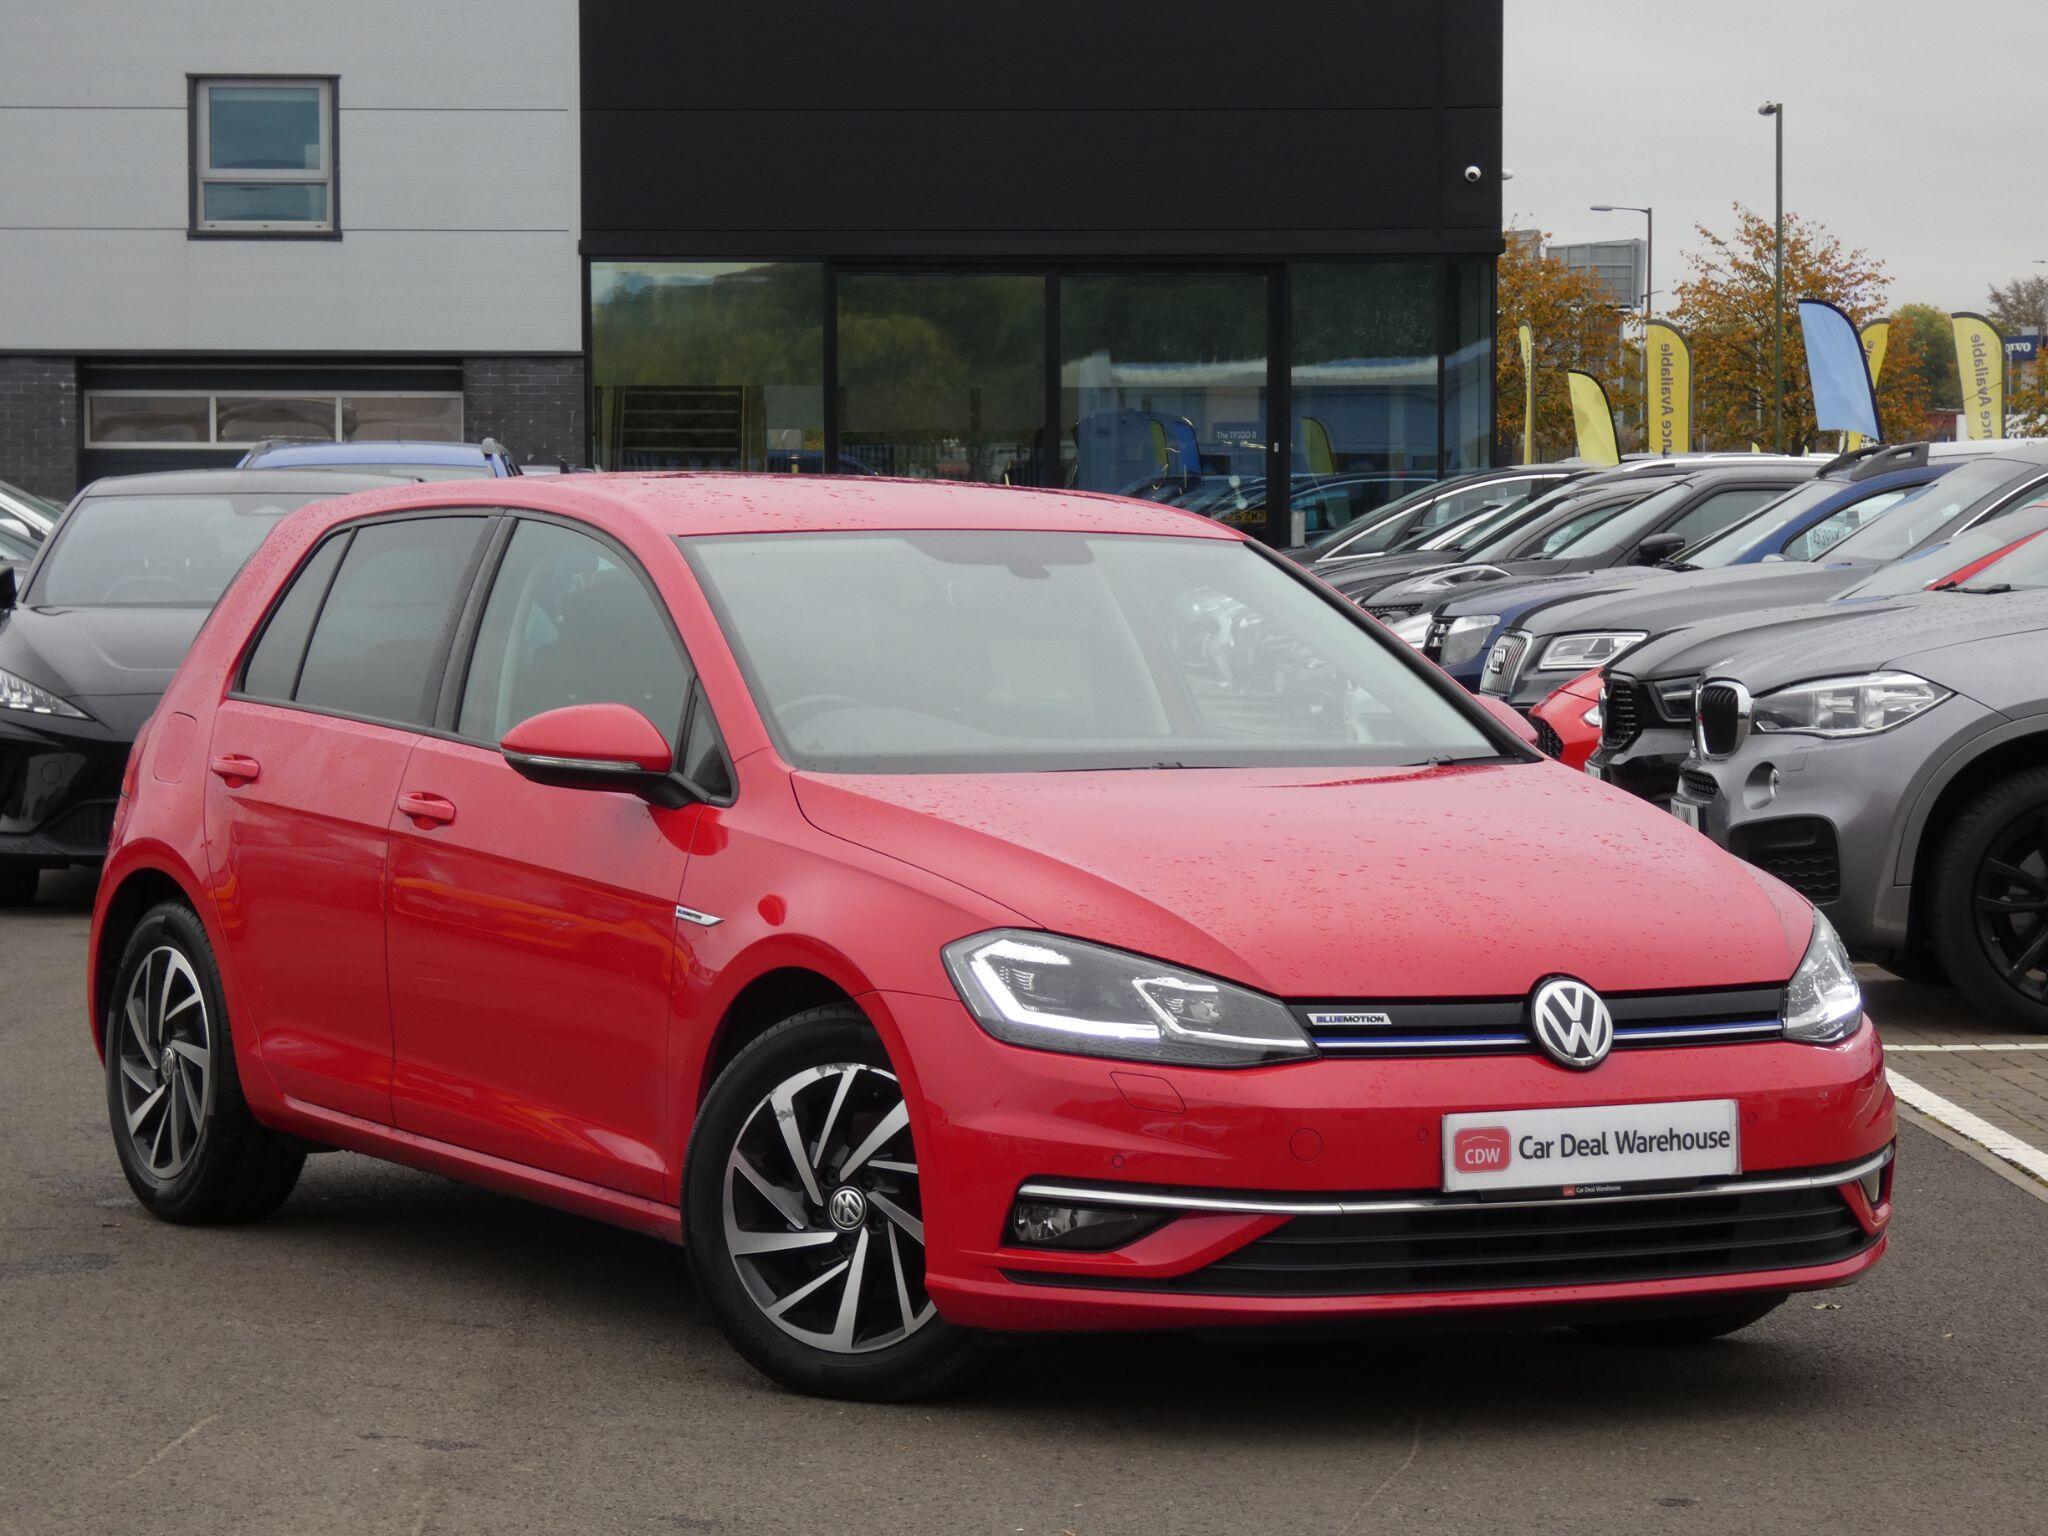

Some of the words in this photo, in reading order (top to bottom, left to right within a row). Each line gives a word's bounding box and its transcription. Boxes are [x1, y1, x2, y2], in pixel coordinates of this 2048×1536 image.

[2005, 342, 2032, 352] OLVO
[1316, 1015, 1385, 1023] BLUEMOTION
[1518, 1135, 1554, 1160] Car
[1560, 1132, 1608, 1158] Deal
[1614, 1127, 1730, 1154] Warehouse
[1464, 1147, 1500, 1165] CDW
